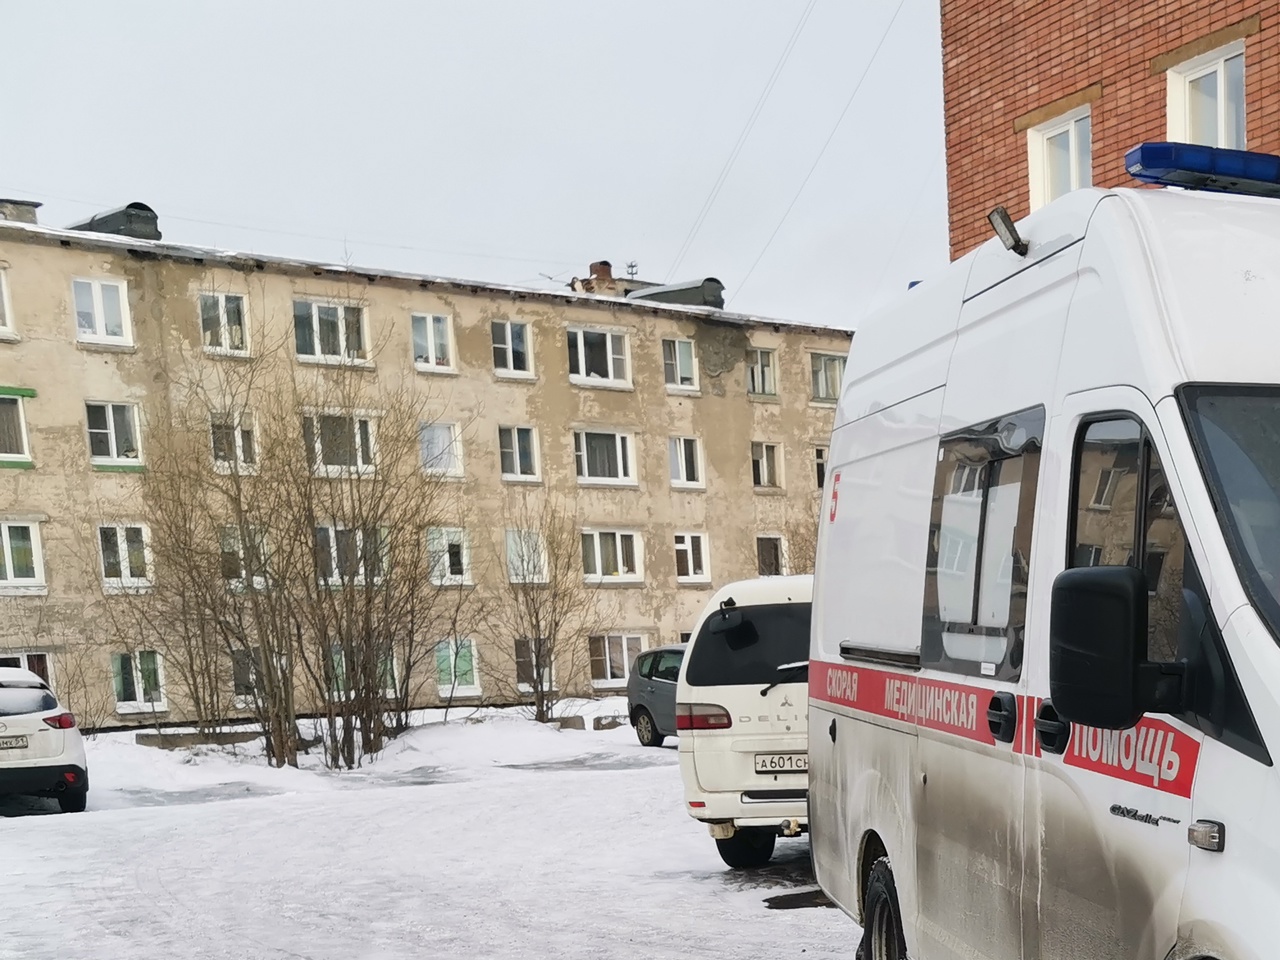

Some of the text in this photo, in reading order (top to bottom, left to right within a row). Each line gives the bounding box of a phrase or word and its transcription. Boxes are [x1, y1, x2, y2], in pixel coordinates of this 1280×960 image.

[826, 667, 1180, 787] СКОРАЯ МЕДИЦИНСКАЯ ПОМОЩЬ
